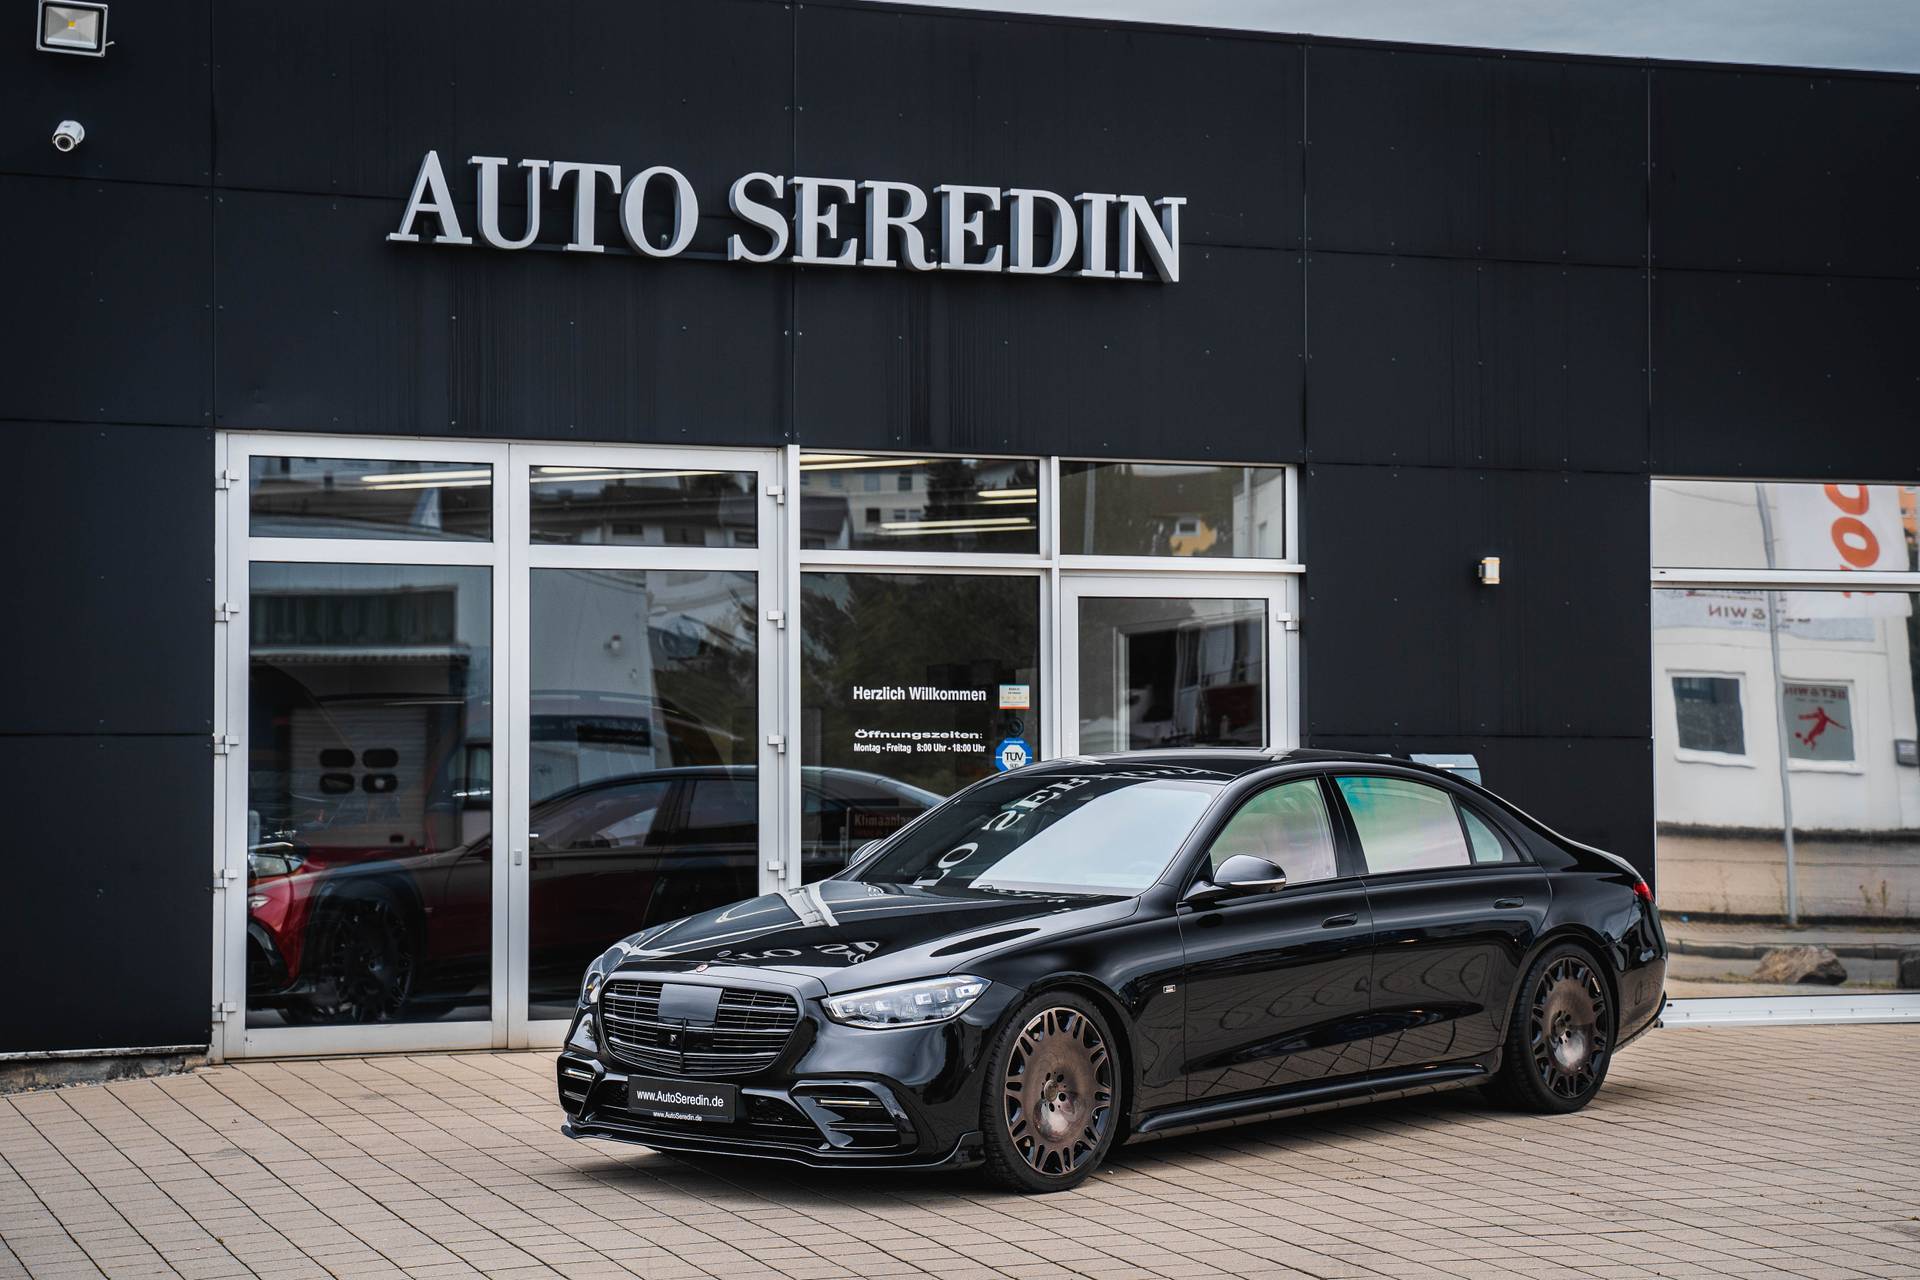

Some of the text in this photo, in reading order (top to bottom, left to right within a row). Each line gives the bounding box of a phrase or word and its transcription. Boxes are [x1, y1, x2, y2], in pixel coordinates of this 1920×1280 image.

[386, 150, 1187, 283] AUTO SEREDIN
[853, 686, 987, 701] Herzlich Willkommen
[854, 729, 983, 740] Öffnungszeiten:
[853, 743, 881, 754] Montag
[886, 743, 912, 754] Freitag
[916, 743, 932, 752] 8:00
[933, 743, 947, 753] Uhr
[952, 743, 971, 753] 18:00
[972, 744, 986, 753] Uhr
[1004, 751, 1024, 762] TÜV
[636, 1090, 724, 1108] www.AutoSeredin.de
[653, 1111, 703, 1122] www.AutoSeredin.de
